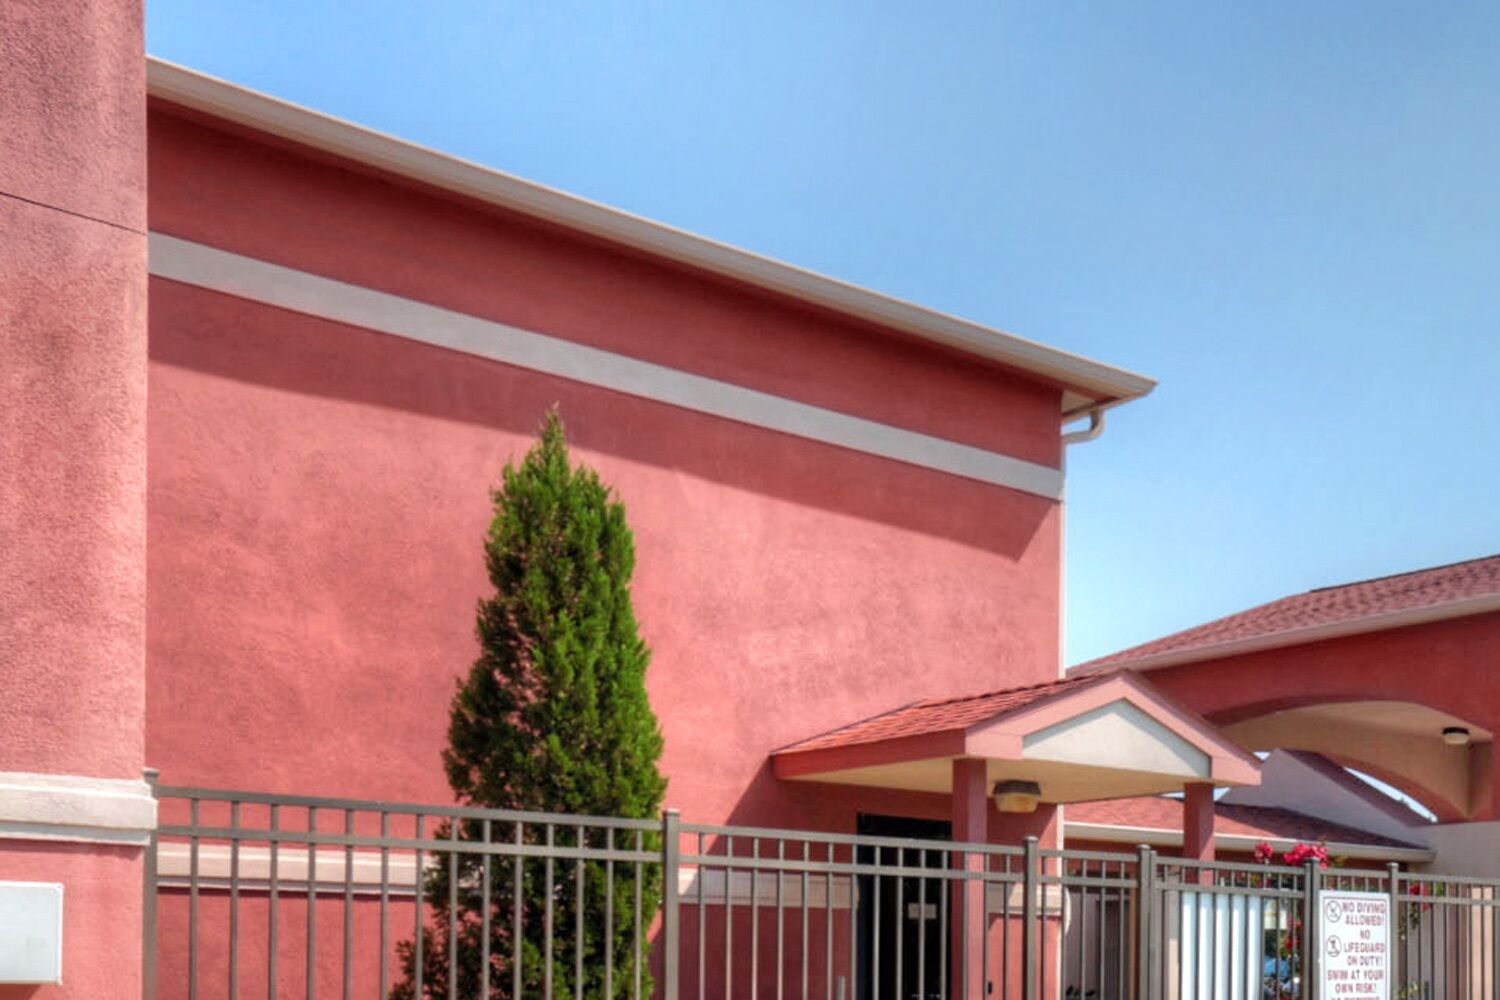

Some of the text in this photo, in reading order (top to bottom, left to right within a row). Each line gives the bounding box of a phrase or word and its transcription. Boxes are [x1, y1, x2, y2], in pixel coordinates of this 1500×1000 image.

[1342, 902, 1385, 913] NO DIVING
[1345, 915, 1384, 925] ALLOWED!
[1360, 929, 1371, 939] NO
[1344, 942, 1385, 953] LIFEGUARD
[1347, 955, 1358, 966] ON
[1327, 969, 1384, 981] SWIM AT YOUR
[1335, 983, 1353, 994] OWN
